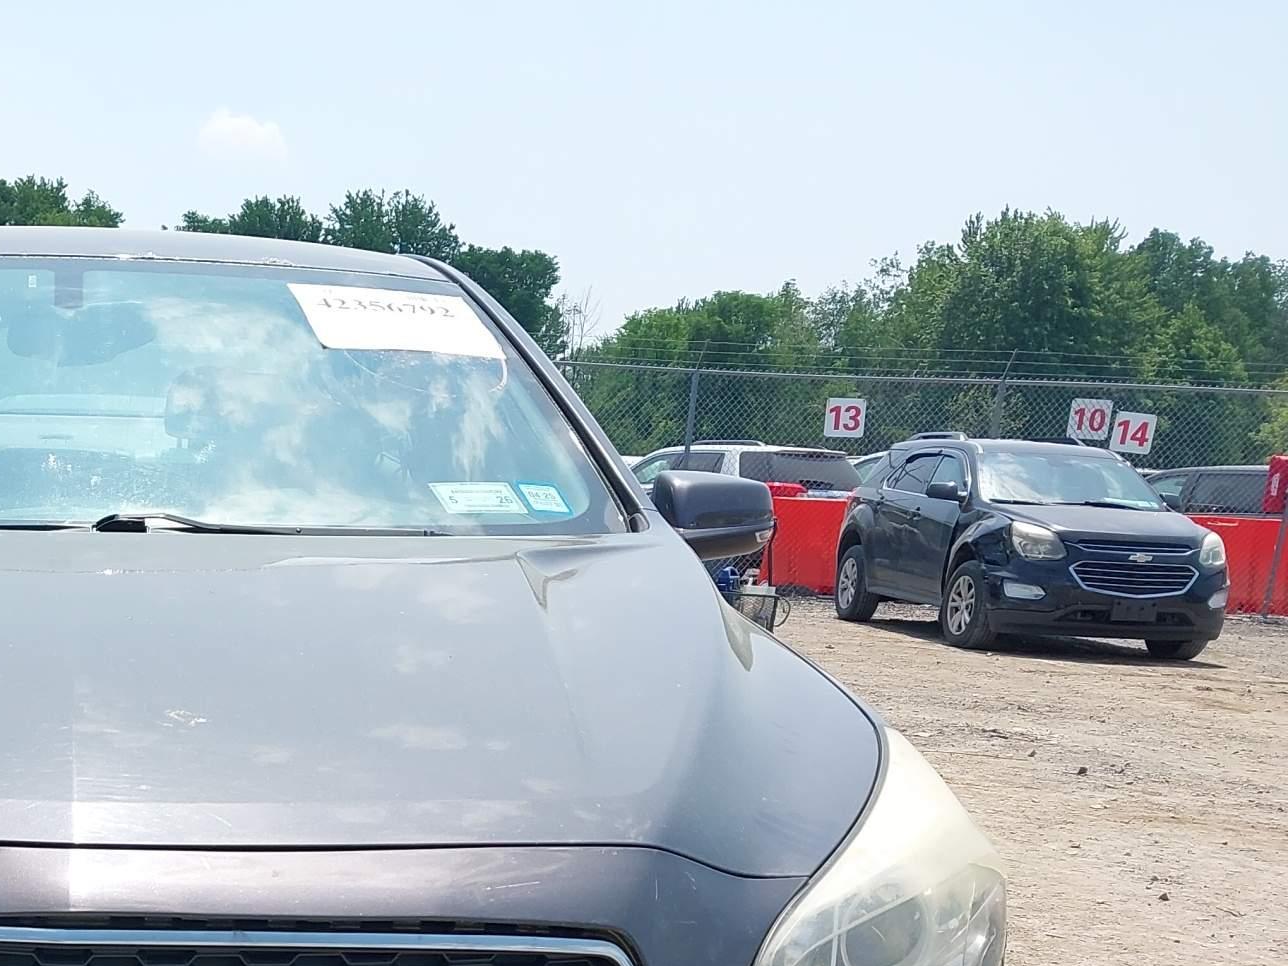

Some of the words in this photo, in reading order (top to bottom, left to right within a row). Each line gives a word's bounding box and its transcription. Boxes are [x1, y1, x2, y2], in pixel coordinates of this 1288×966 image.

[829, 405, 862, 431] 13
[1074, 408, 1106, 432] 10
[1117, 420, 1149, 447] 14
